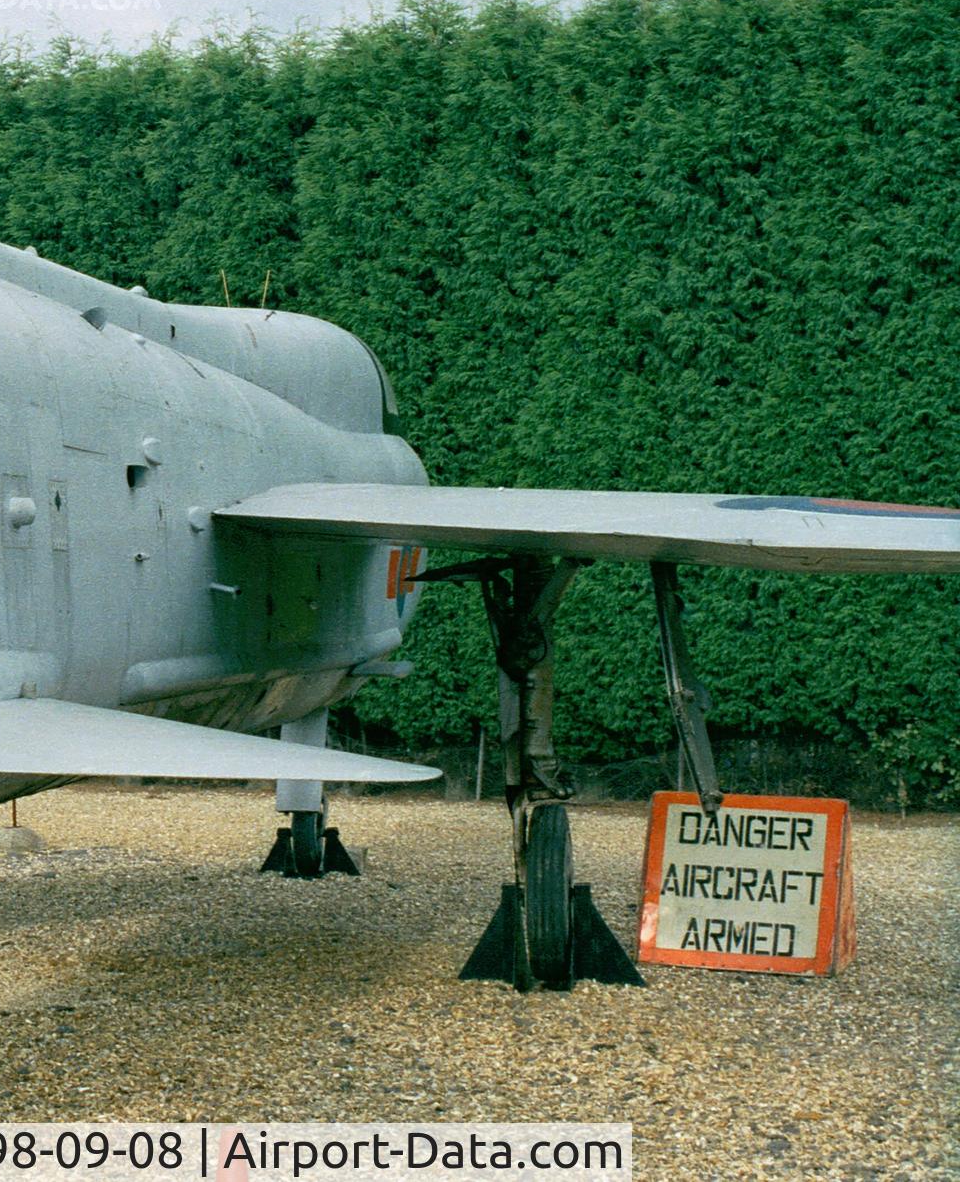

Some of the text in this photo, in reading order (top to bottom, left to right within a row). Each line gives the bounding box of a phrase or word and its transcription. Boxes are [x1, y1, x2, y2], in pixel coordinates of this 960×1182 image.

[679, 811, 814, 851] DANGER
[660, 863, 825, 906] AIRCRAFT
[681, 917, 796, 958] ARMED
